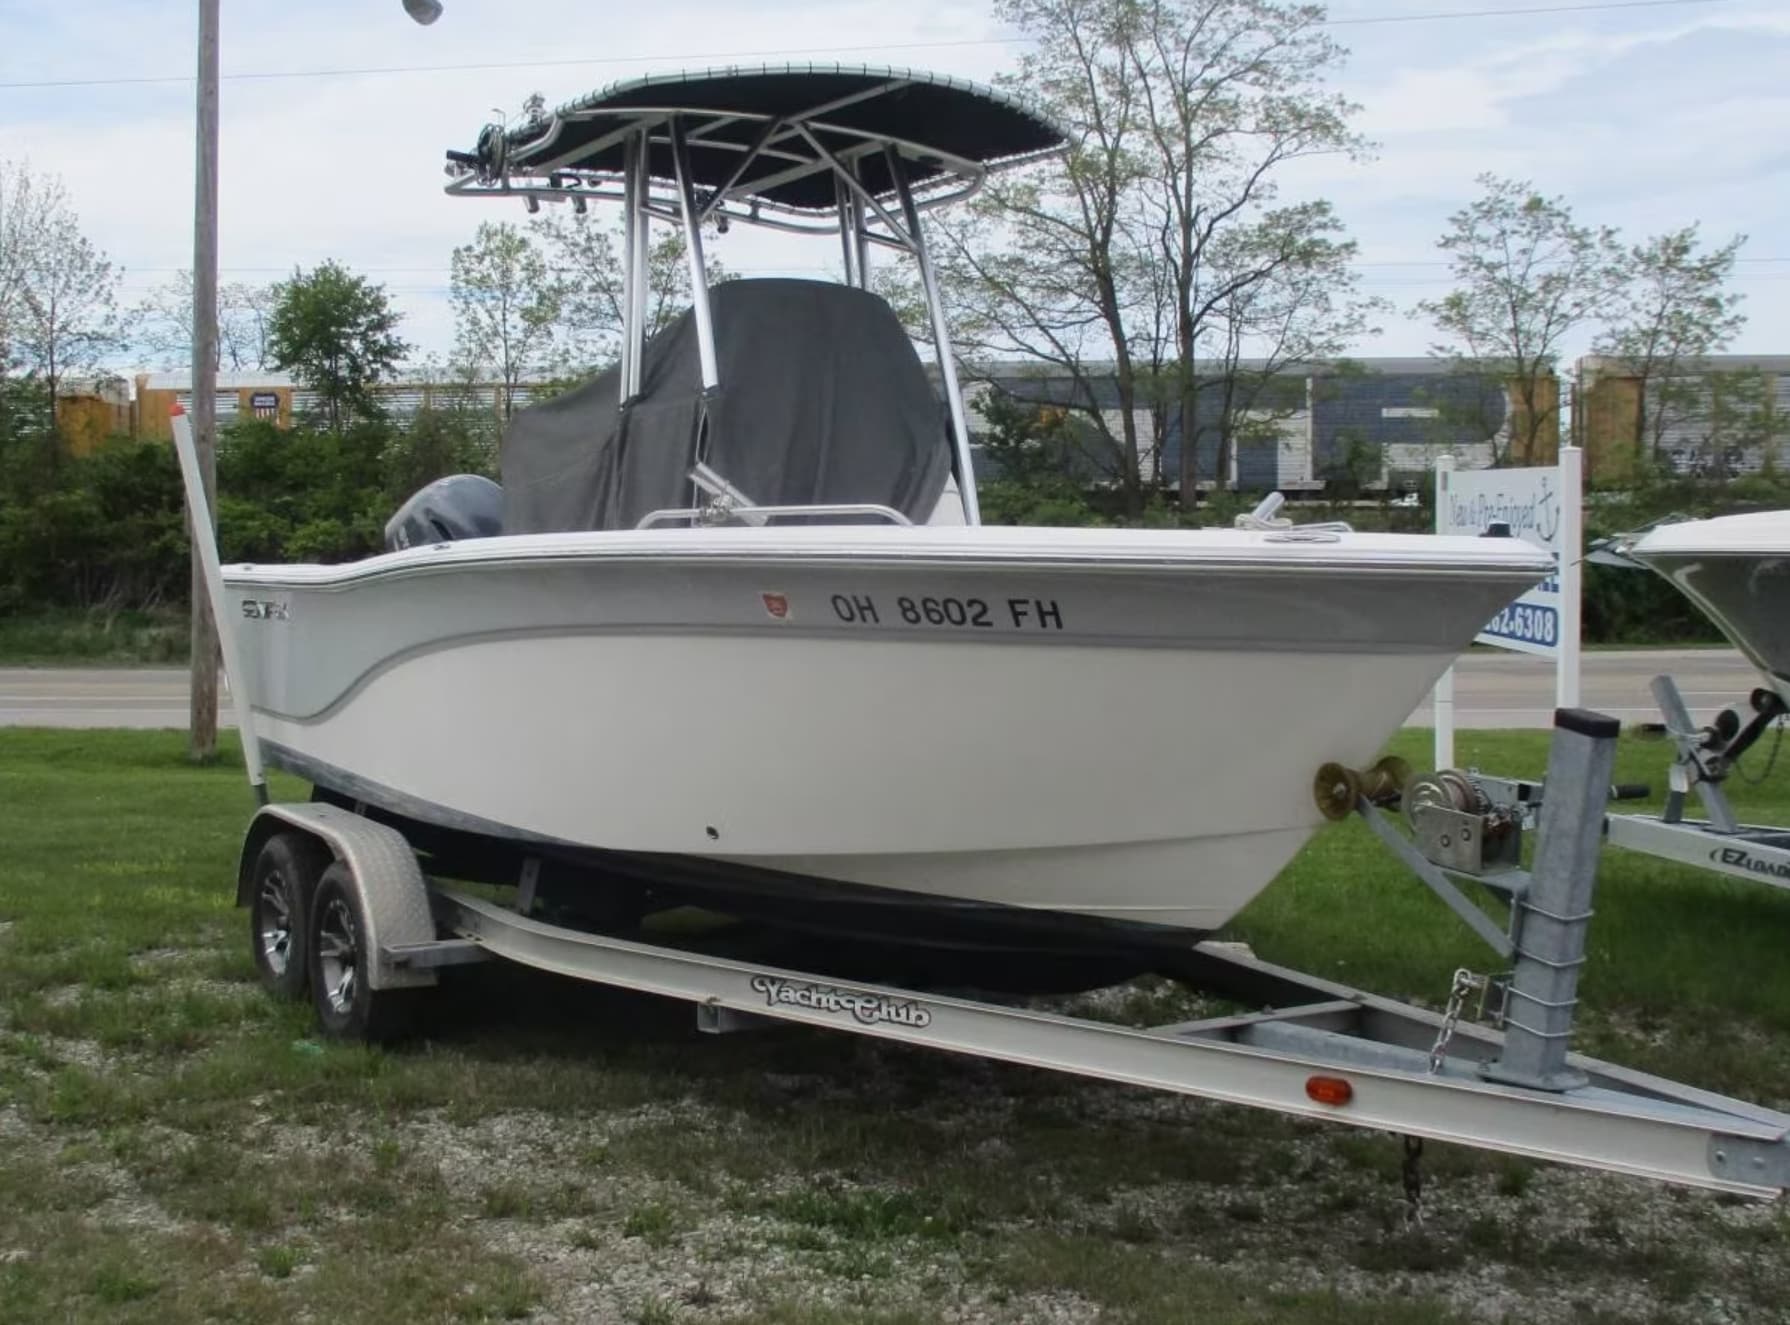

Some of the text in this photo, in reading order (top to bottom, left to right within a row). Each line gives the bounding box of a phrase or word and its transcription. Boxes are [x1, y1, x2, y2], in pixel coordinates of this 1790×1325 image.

[830, 594, 1064, 630] OH 8602 FH
